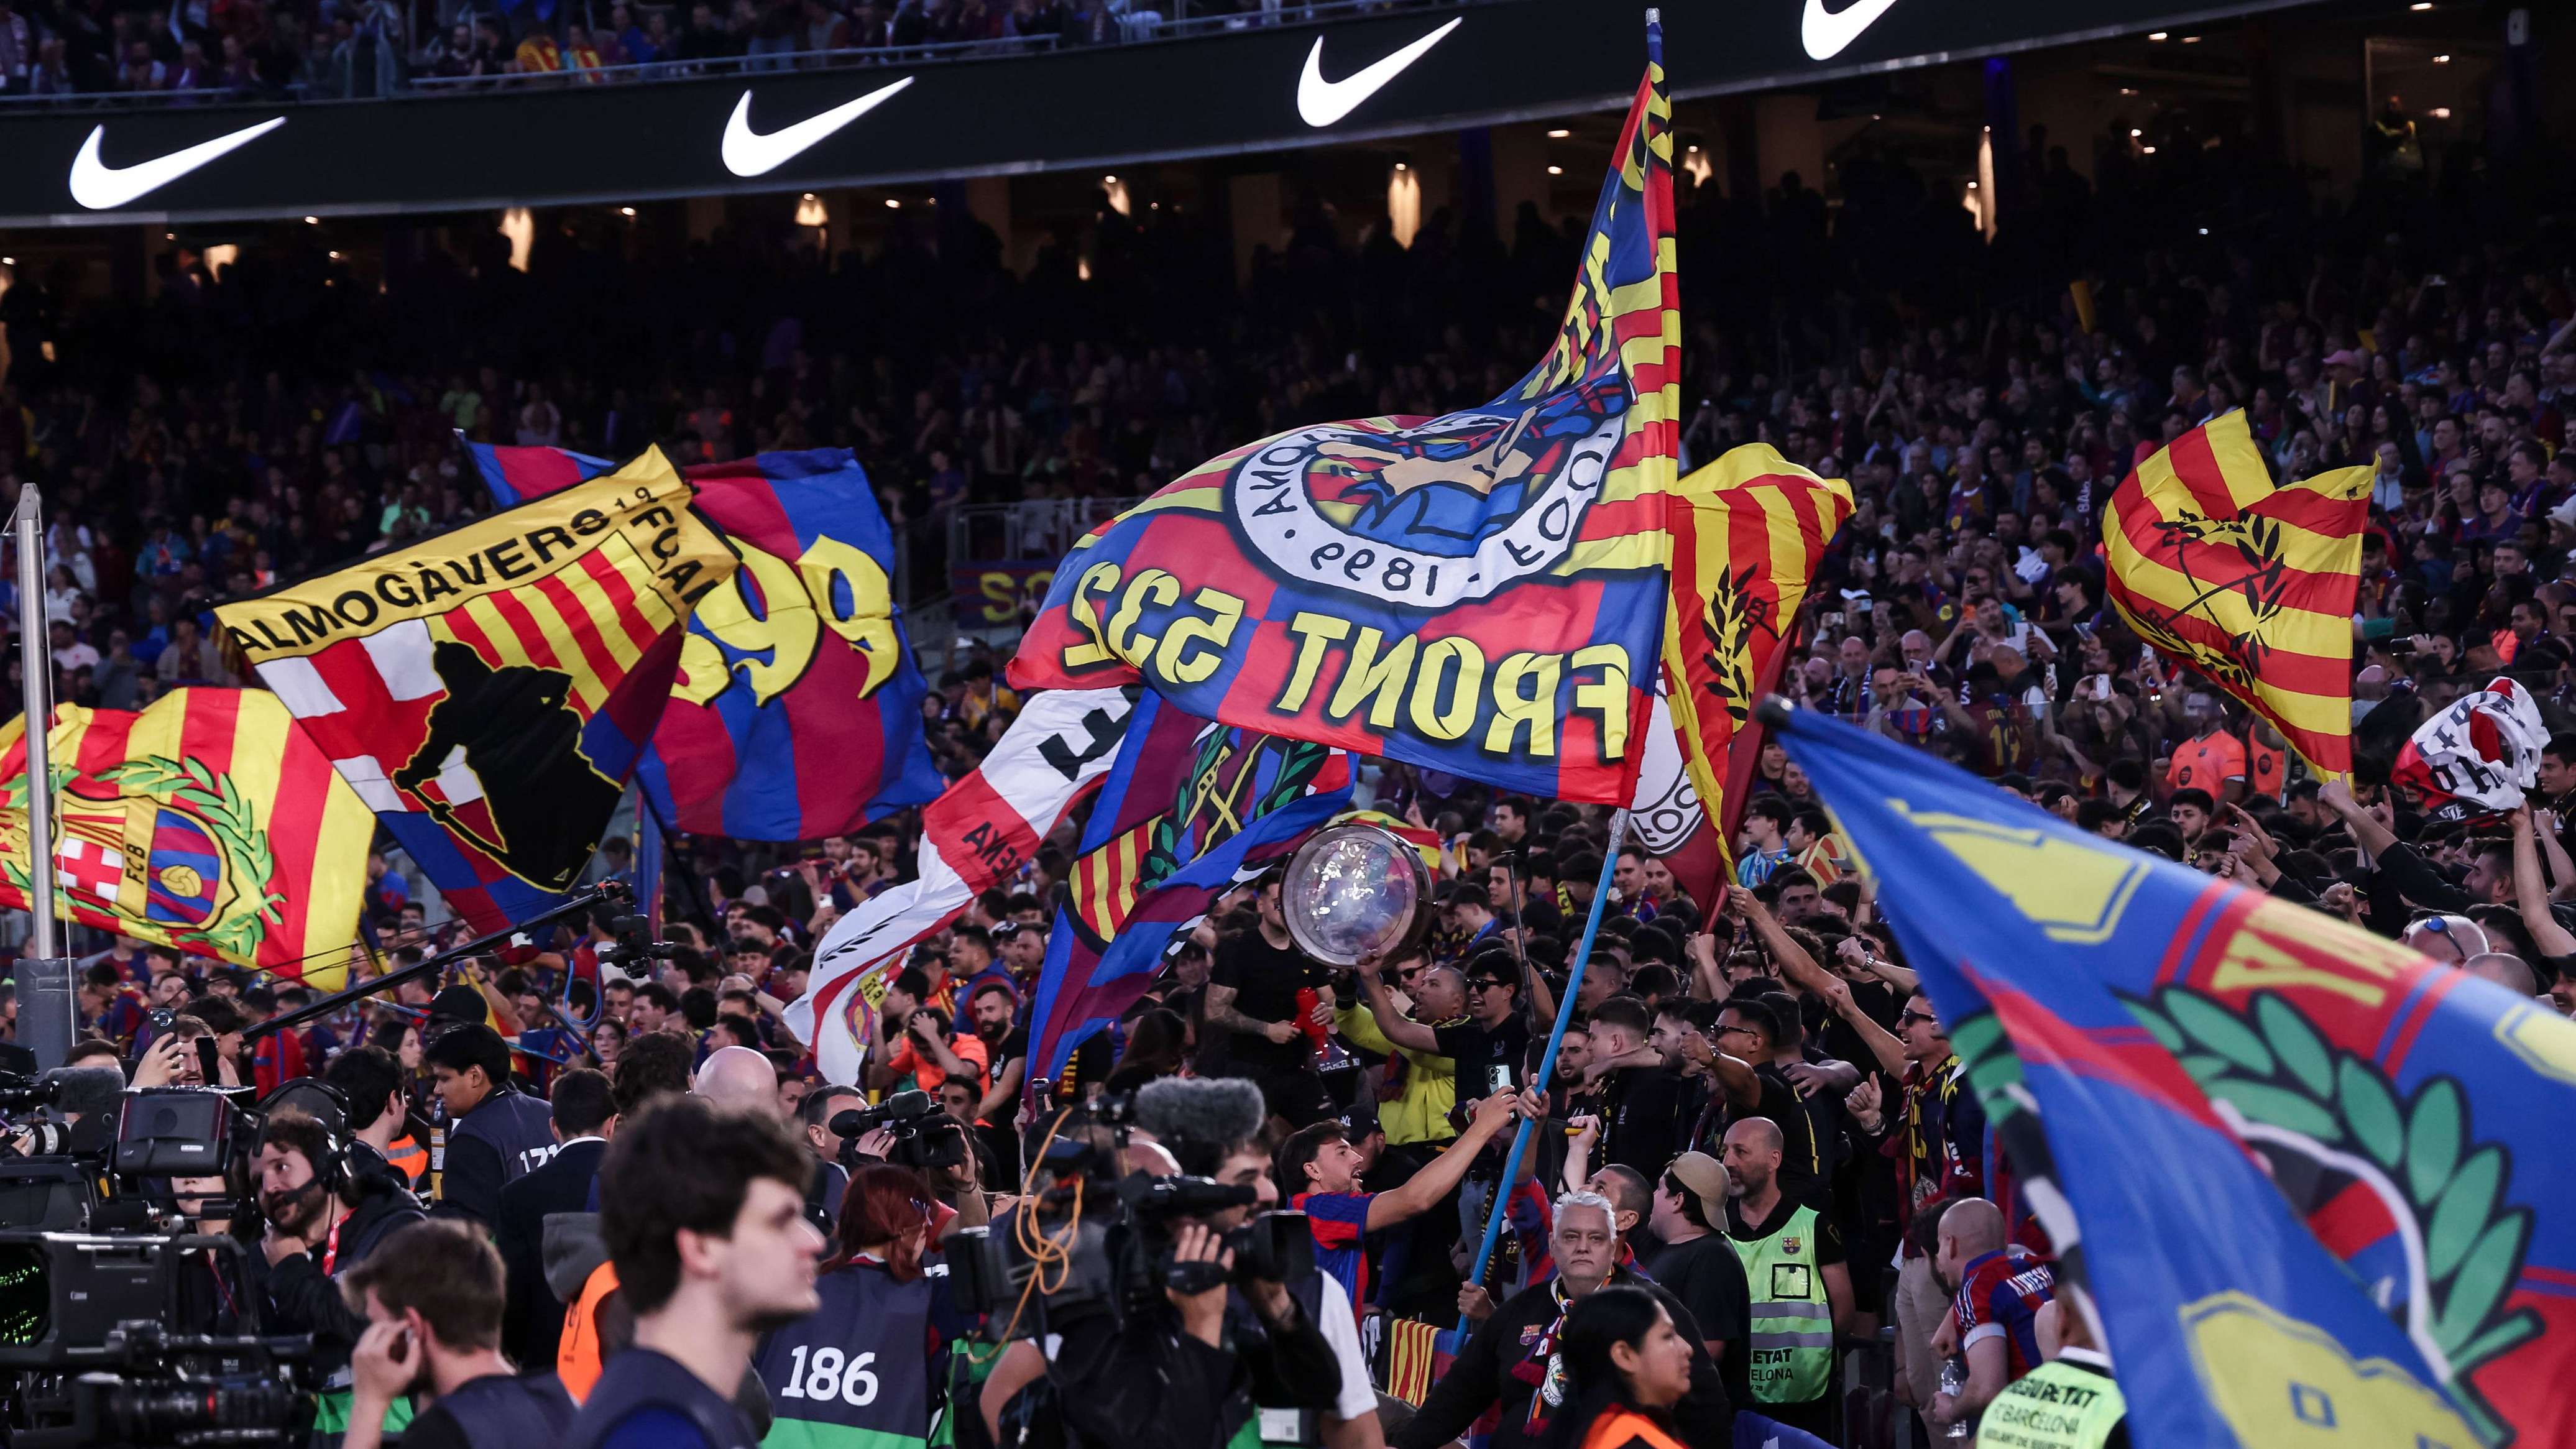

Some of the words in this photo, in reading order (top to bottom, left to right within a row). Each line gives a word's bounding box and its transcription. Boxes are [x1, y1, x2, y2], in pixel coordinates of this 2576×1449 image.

[228, 508, 610, 651] ALMOGÀVERS
[126, 843, 147, 886] FCB
[781, 1345, 879, 1407] 186
[1750, 1348, 1793, 1364] ETAT
